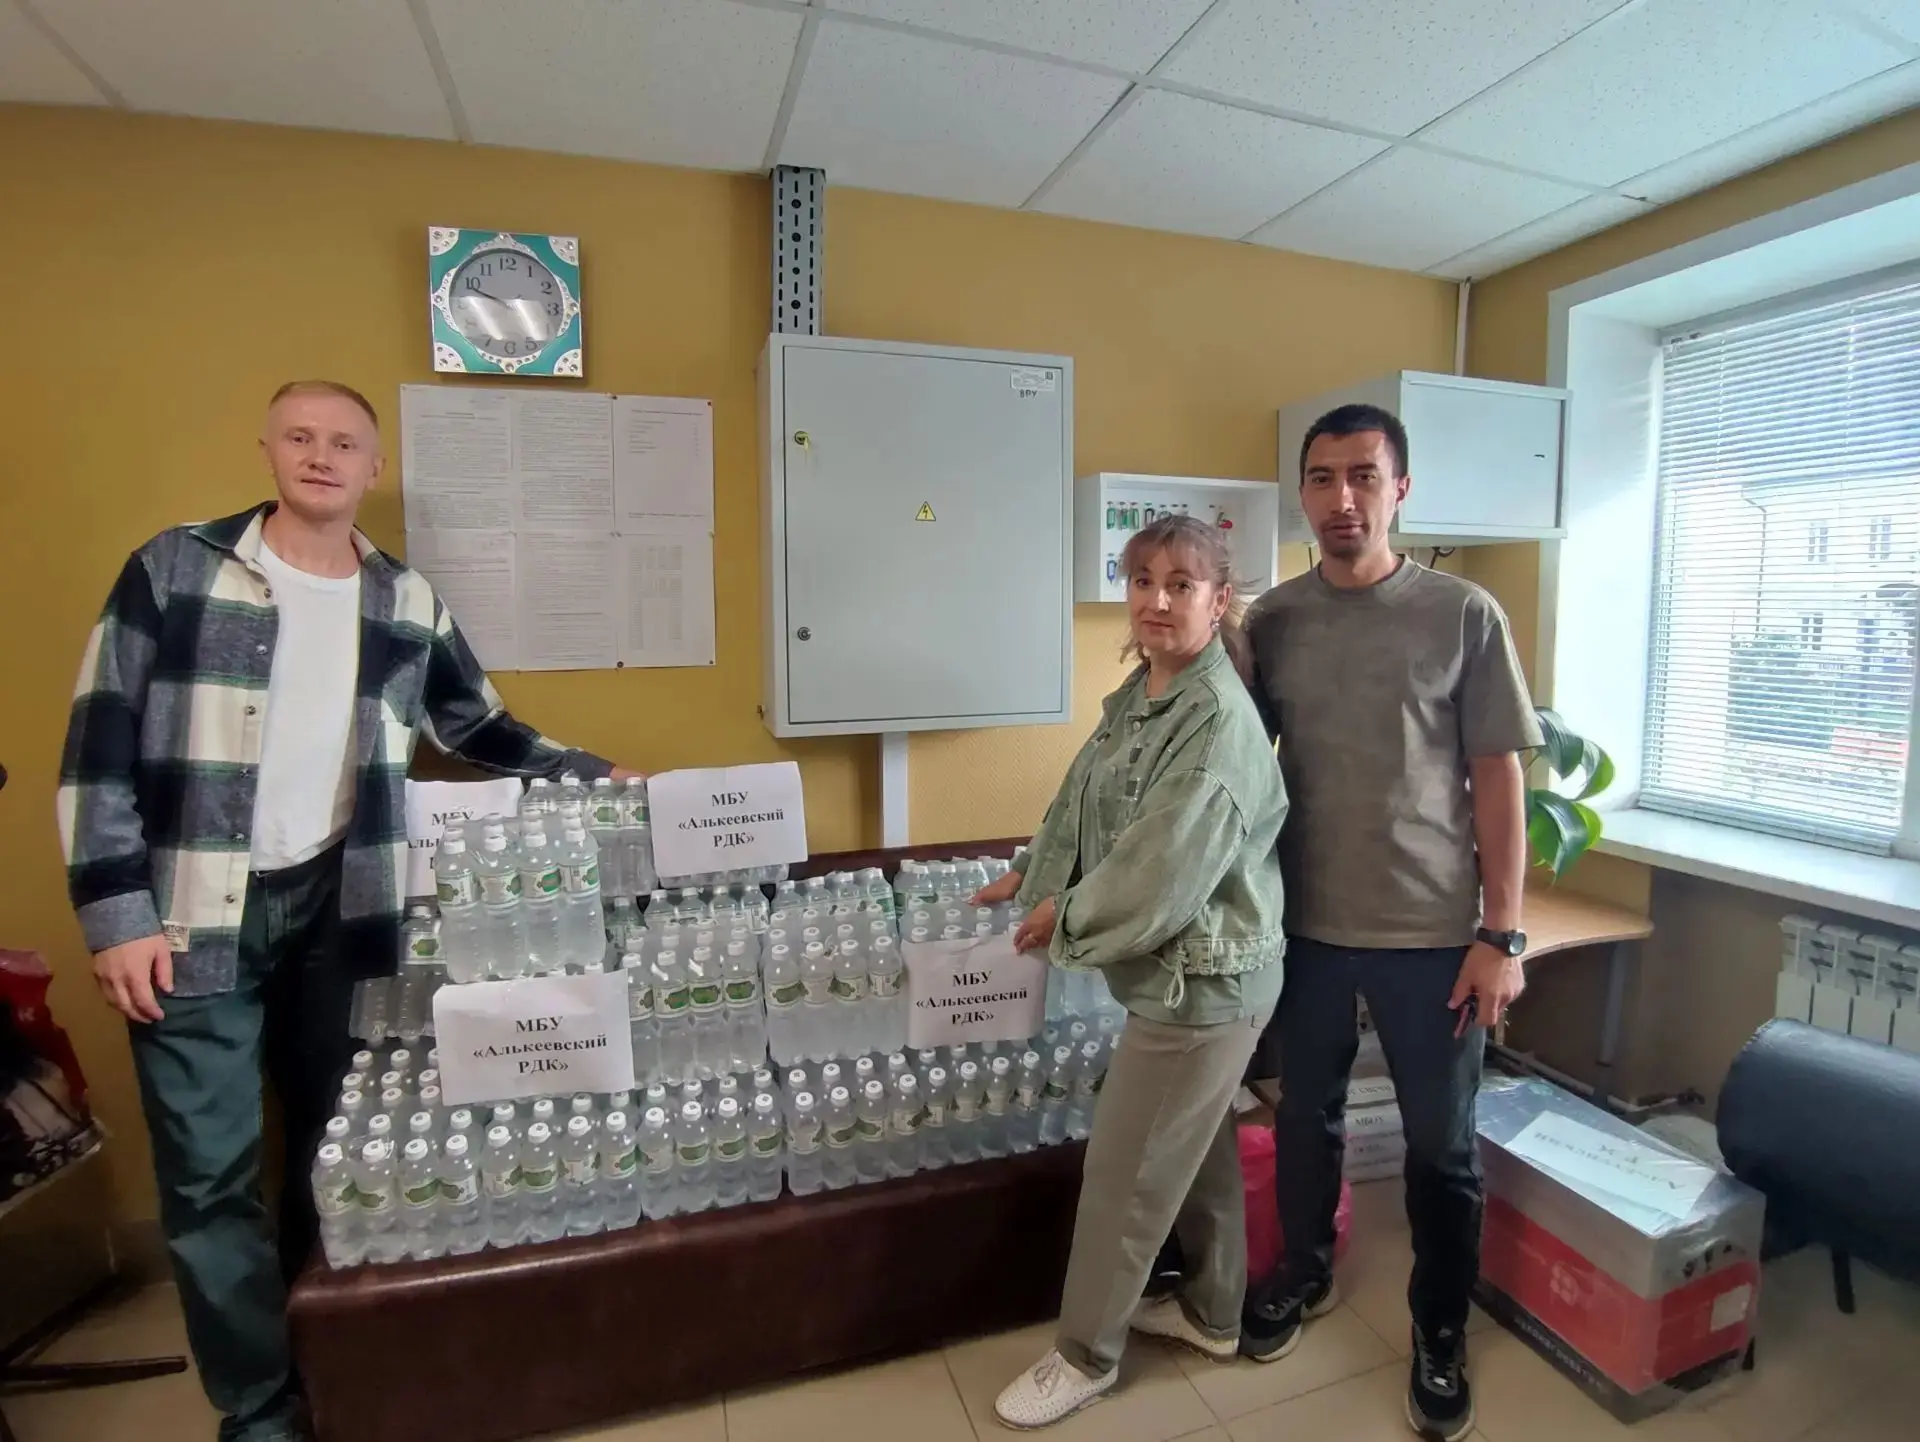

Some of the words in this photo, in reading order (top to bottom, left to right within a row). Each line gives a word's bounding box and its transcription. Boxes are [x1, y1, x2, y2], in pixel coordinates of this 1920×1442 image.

[480, 263, 493, 276] 11
[499, 257, 517, 271] 12
[527, 265, 533, 278] 1
[465, 277, 481, 290] 10
[541, 282, 553, 295] 2
[547, 302, 559, 316] 3
[504, 341, 516, 355] 6
[525, 337, 538, 351] 5
[711, 791, 749, 807] МБУ
[678, 809, 785, 831] «Алькеевский
[713, 832, 755, 848] РДК»
[952, 970, 993, 987] МБУ
[916, 987, 1028, 1009] «Алькеевский
[516, 1015, 564, 1033] МБУ
[952, 1011, 995, 1026] РДК»
[473, 1034, 608, 1058] «Алькеевский
[518, 1058, 570, 1075] РДК»
